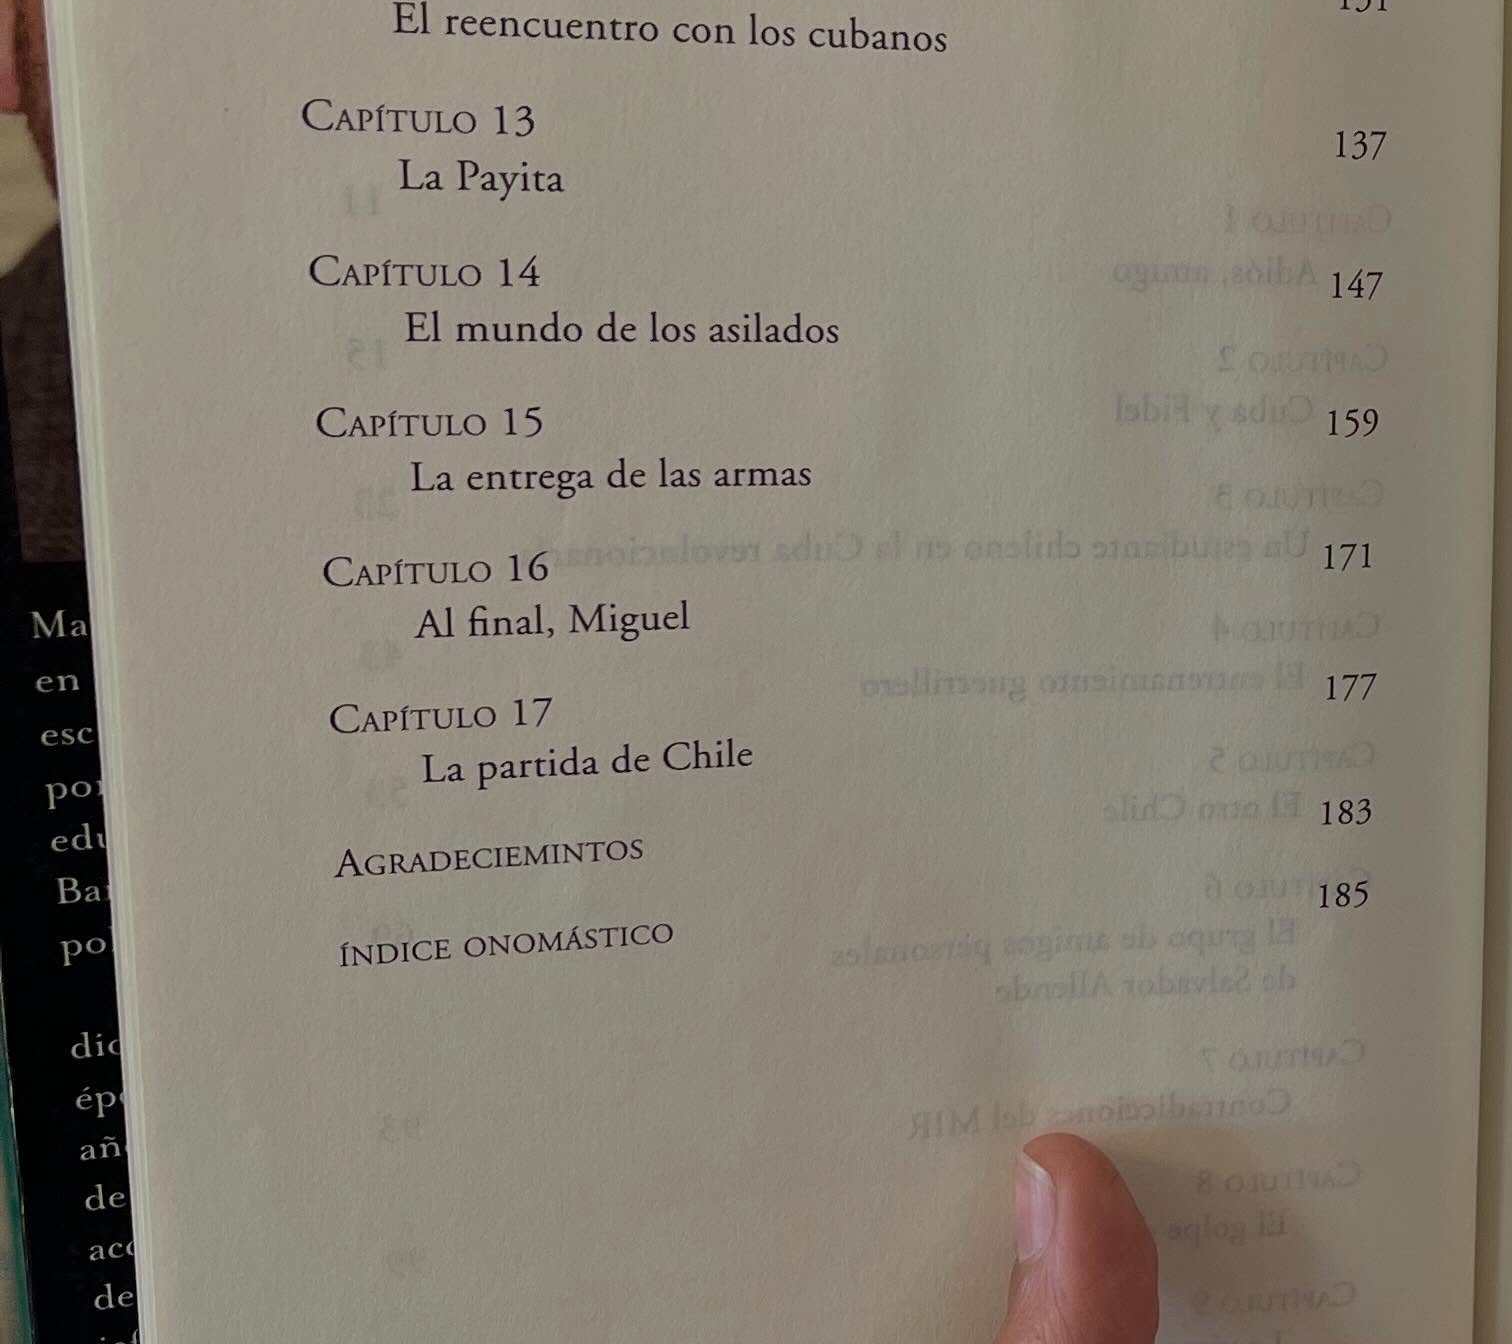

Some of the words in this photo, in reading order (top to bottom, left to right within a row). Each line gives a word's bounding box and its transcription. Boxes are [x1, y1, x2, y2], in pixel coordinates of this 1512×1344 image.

[393, 1, 430, 34] El
[445, 16, 658, 41] reencuentro
[673, 23, 735, 44] con
[750, 13, 795, 46] los
[809, 17, 947, 52] cubanos
[302, 99, 476, 134] CAPÍTULO
[495, 106, 534, 137] 13
[1336, 131, 1386, 160] 137
[399, 159, 443, 190] La
[457, 160, 565, 201] Payita
[310, 255, 481, 286] CAPÍTULO
[500, 255, 540, 286] 14
[1333, 269, 1383, 300] 147
[405, 310, 441, 342] El
[456, 311, 582, 342] mundo
[597, 311, 636, 342] de
[650, 312, 696, 342] los
[710, 312, 838, 343] asilados
[317, 407, 486, 437] CAPÍTULO
[504, 407, 542, 437] 15
[1329, 409, 1378, 438] 159
[411, 462, 454, 491] La
[467, 470, 594, 499] entrega
[607, 458, 645, 488] de
[659, 457, 700, 487] las
[715, 468, 811, 486] armas
[323, 557, 491, 587] CAPÍTULO
[509, 551, 548, 581] 16
[1325, 544, 1370, 571] 171
[414, 607, 454, 638] Al
[469, 604, 554, 638] final,
[569, 600, 690, 641] Miguel
[34, 673, 80, 693] en
[1327, 673, 1377, 701] 177
[330, 704, 496, 733] CAPÍTULO
[514, 698, 552, 727] 17
[422, 754, 465, 782] La
[478, 746, 599, 790] partida
[612, 744, 649, 773] de
[663, 738, 752, 770] Chile
[1323, 799, 1371, 825] 183
[334, 839, 642, 878] AGRADECIEMINTOS
[1320, 880, 1368, 908] 185
[341, 939, 451, 967] ÍNDICE
[464, 924, 673, 957] ONOMÁSTICO
[85, 1184, 126, 1211] de
[94, 1283, 134, 1310] de
